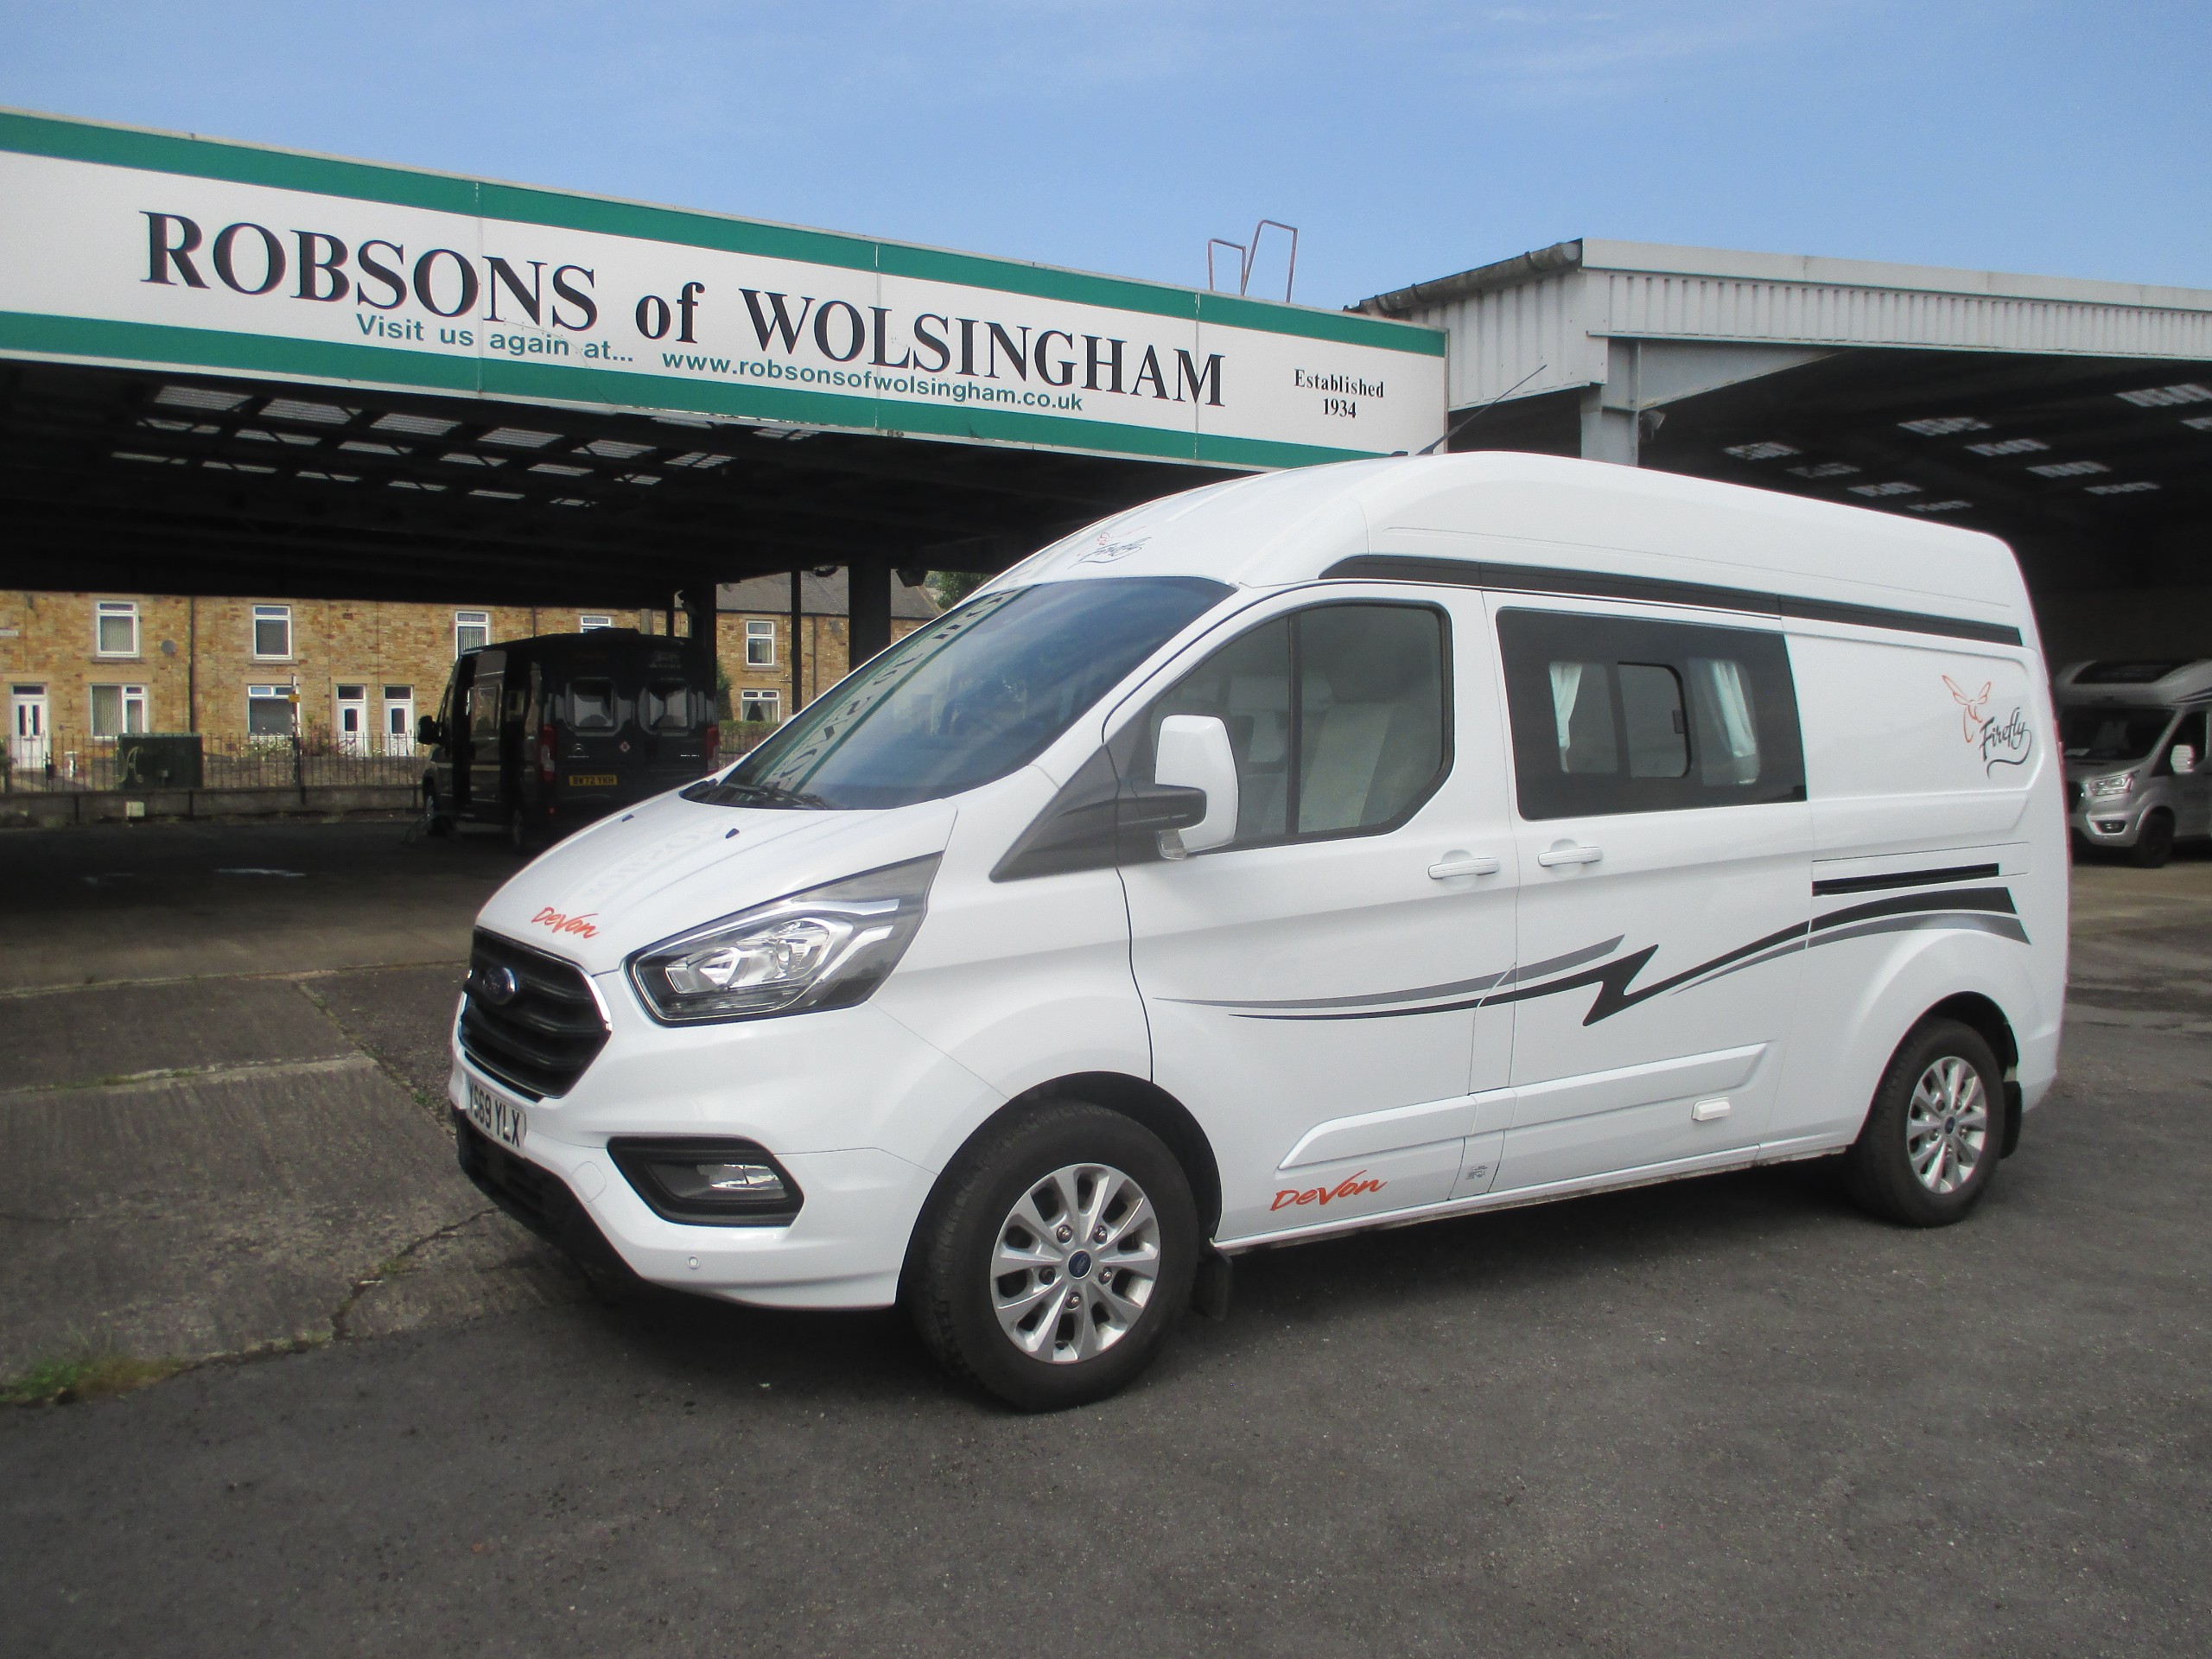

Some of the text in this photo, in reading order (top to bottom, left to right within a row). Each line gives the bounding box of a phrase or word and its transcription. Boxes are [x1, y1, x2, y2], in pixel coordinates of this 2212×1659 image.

[139, 210, 1226, 408] ROBSONS of WOLSINGHAM
[356, 313, 634, 363] Visit us again at...
[661, 352, 1084, 411] www.robsonsofwolsingham.co.uk
[1294, 368, 1384, 398] Established
[1323, 398, 1357, 419] 1934
[1978, 707, 2032, 779] Firefly
[494, 1099, 520, 1149] YLX
